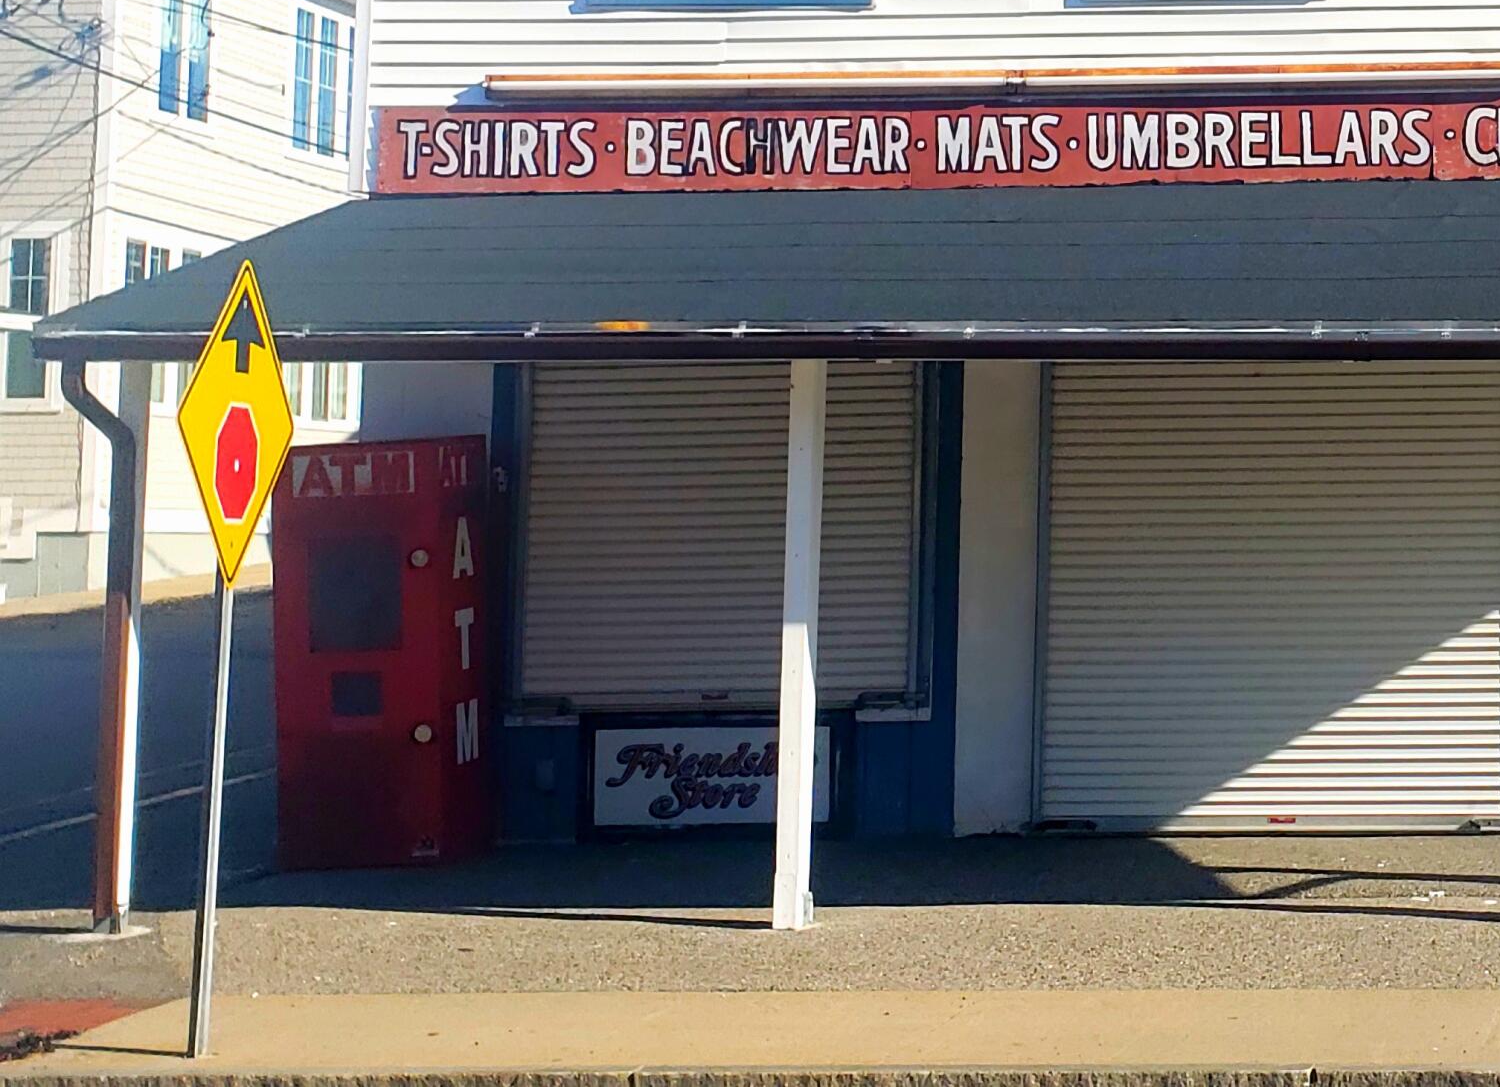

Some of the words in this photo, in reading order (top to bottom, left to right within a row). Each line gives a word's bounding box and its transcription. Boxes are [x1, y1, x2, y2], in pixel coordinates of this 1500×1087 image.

[398, 116, 598, 179] T-SHIRTS
[623, 115, 910, 178] BEACHWEAR
[936, 113, 1063, 173] MATS
[1085, 108, 1434, 171] UMBRELLARS
[605, 742, 778, 788] Friendsh
[648, 776, 761, 820] Store
